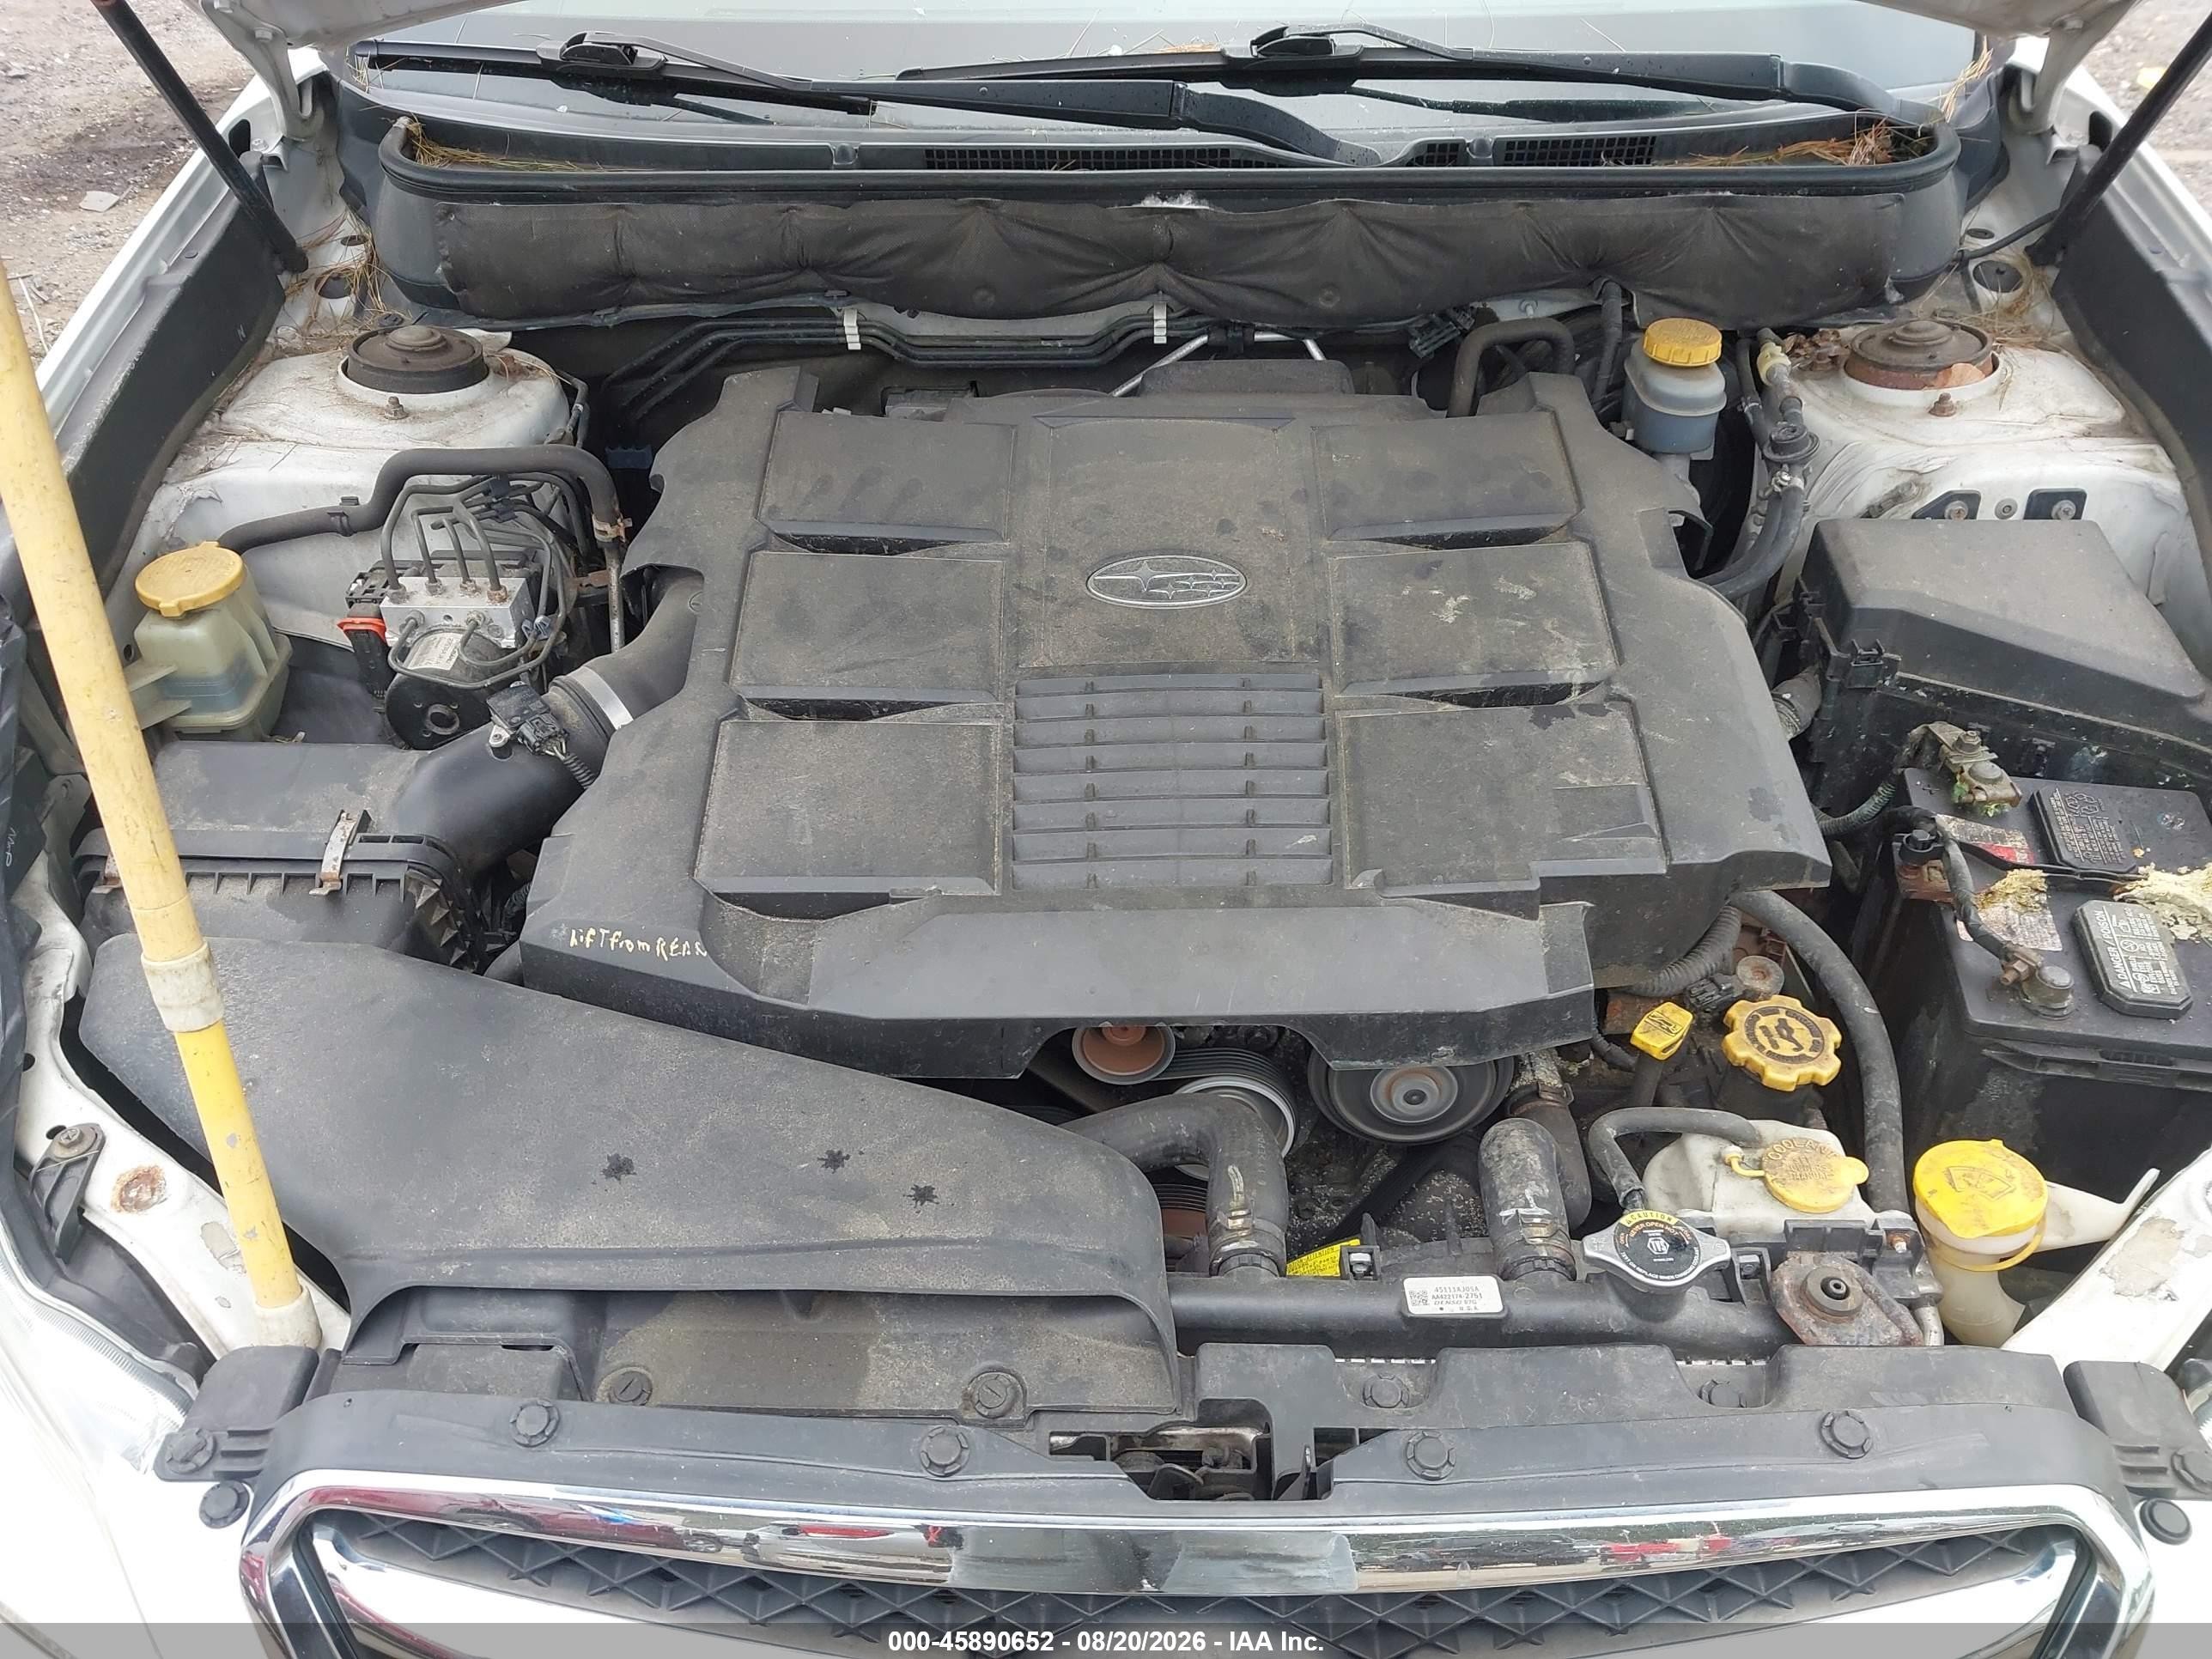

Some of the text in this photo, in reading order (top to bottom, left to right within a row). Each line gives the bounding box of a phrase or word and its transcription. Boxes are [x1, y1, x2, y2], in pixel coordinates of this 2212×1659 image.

[2094, 910, 2113, 939] POISON
[2107, 946, 2130, 981] DANGER
[1632, 1212, 1674, 1223] CAUTION
